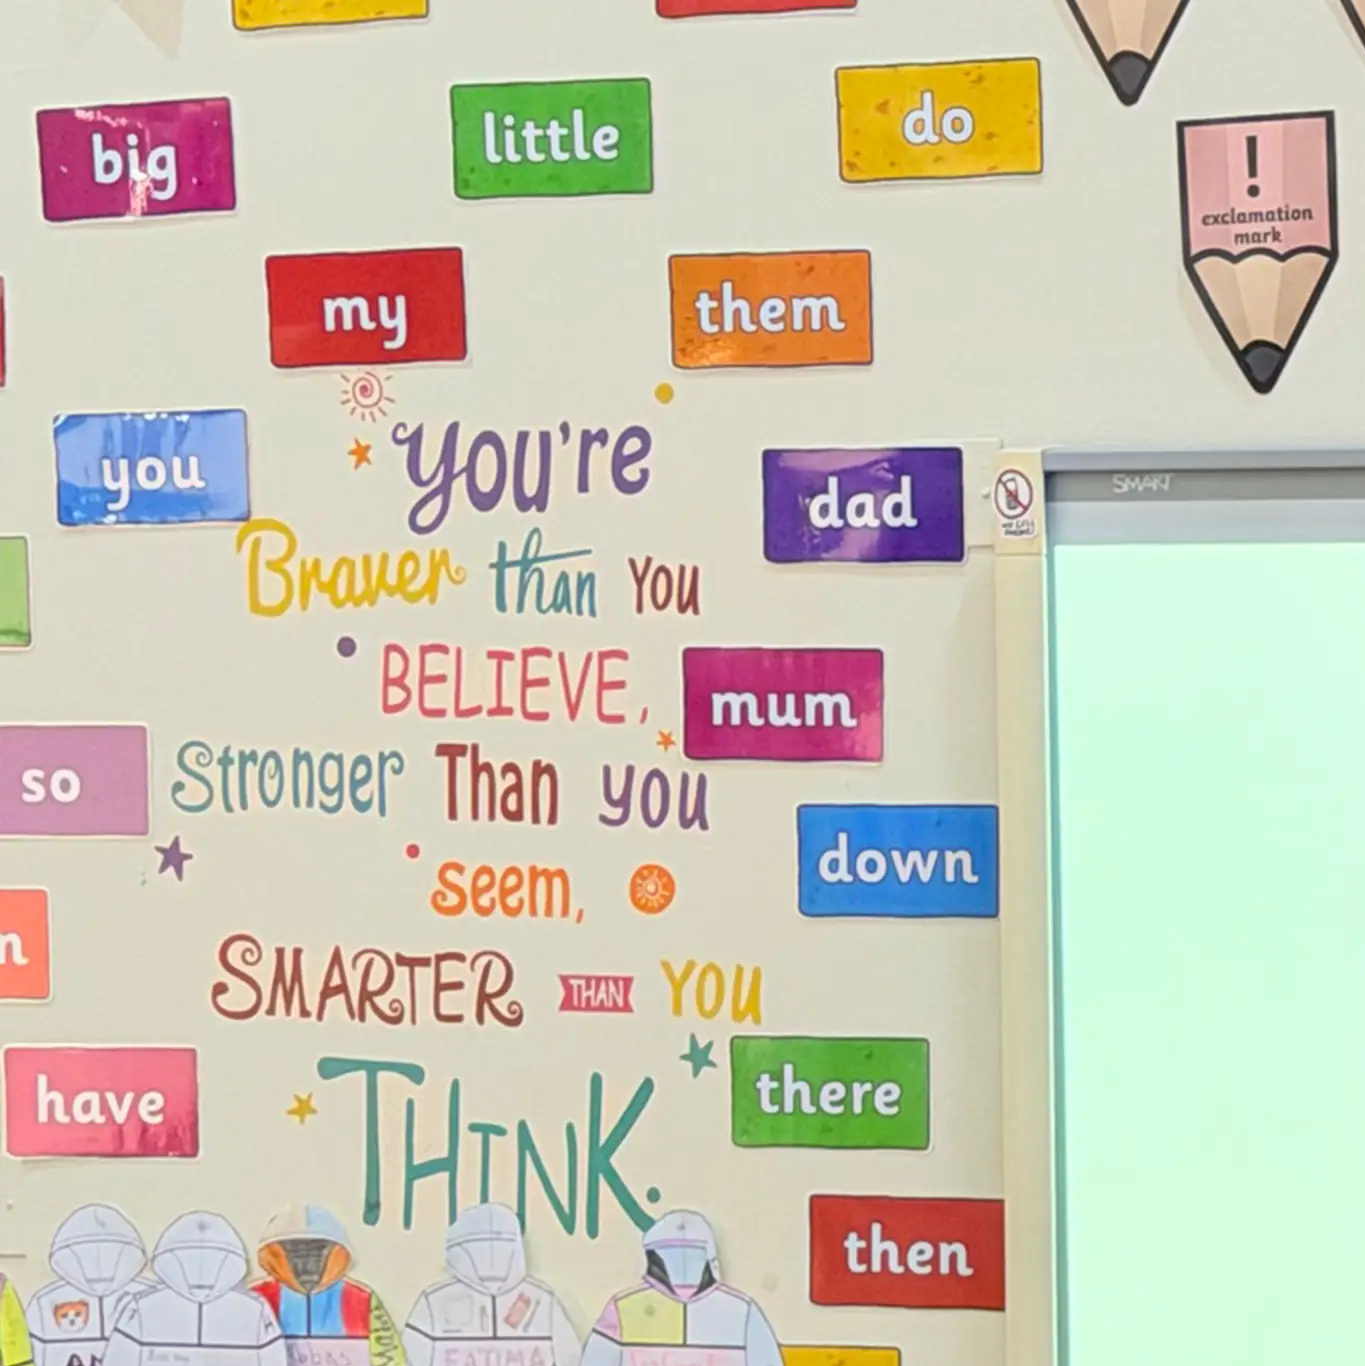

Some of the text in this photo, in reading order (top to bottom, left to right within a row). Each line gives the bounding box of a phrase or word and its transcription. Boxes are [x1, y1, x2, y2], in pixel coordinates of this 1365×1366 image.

[482, 109, 620, 165] little
[902, 89, 977, 146] do
[92, 133, 177, 201] big
[1246, 135, 1260, 198] !
[1201, 205, 1314, 228] exclamation
[1234, 226, 1283, 245] mark
[322, 293, 408, 350] my
[695, 280, 846, 335] them
[101, 454, 207, 512] you
[807, 475, 918, 530] dad
[1112, 473, 1175, 493] SMART
[235, 518, 467, 617] Braver
[489, 527, 597, 617] than
[381, 642, 649, 725] BELIEVE,
[710, 690, 858, 728] mum
[20, 767, 82, 803] so
[170, 739, 711, 832] Stronger Than you
[818, 832, 980, 886] down
[210, 933, 525, 1028] SMARTER
[568, 978, 626, 1009] THAN
[36, 1073, 165, 1126] have
[755, 1063, 903, 1117] there
[844, 1223, 973, 1277] then
